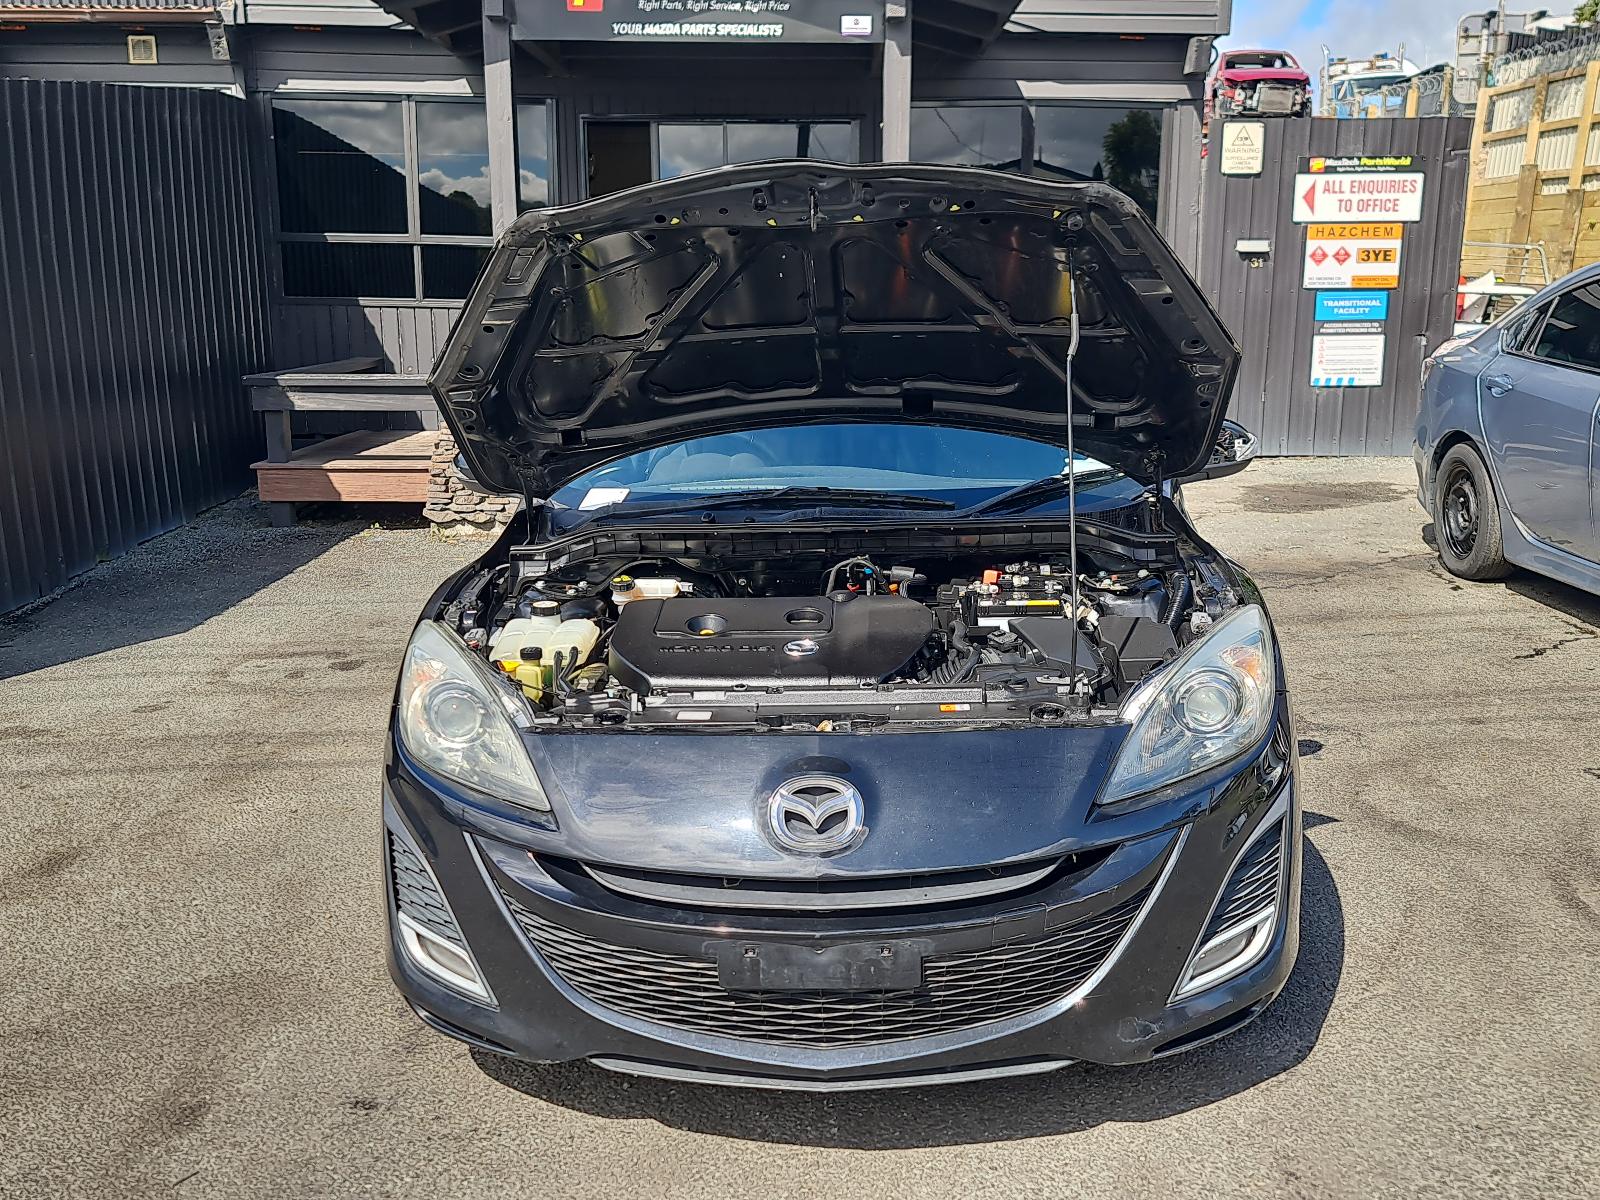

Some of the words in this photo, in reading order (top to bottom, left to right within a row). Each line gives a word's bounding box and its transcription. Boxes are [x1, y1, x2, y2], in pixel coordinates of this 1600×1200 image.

[638, 0, 659, 12] Right
[661, 0, 684, 11] Parts,
[687, 0, 708, 13] Right
[710, 0, 743, 12] Service,
[744, 1, 767, 13] Right
[768, 1, 791, 11] Price
[612, 23, 642, 35] YOUR
[642, 23, 680, 36] MAZDA
[681, 24, 717, 36] PARTS
[717, 24, 783, 37] SPECIALISTS
[1322, 180, 1345, 194] ALL
[1349, 179, 1418, 195] ENQUIRIES
[1338, 199, 1353, 213] TO
[1356, 198, 1400, 213] OFFICE
[1315, 226, 1393, 237] HAZCHEM
[1361, 249, 1392, 262] 3YE
